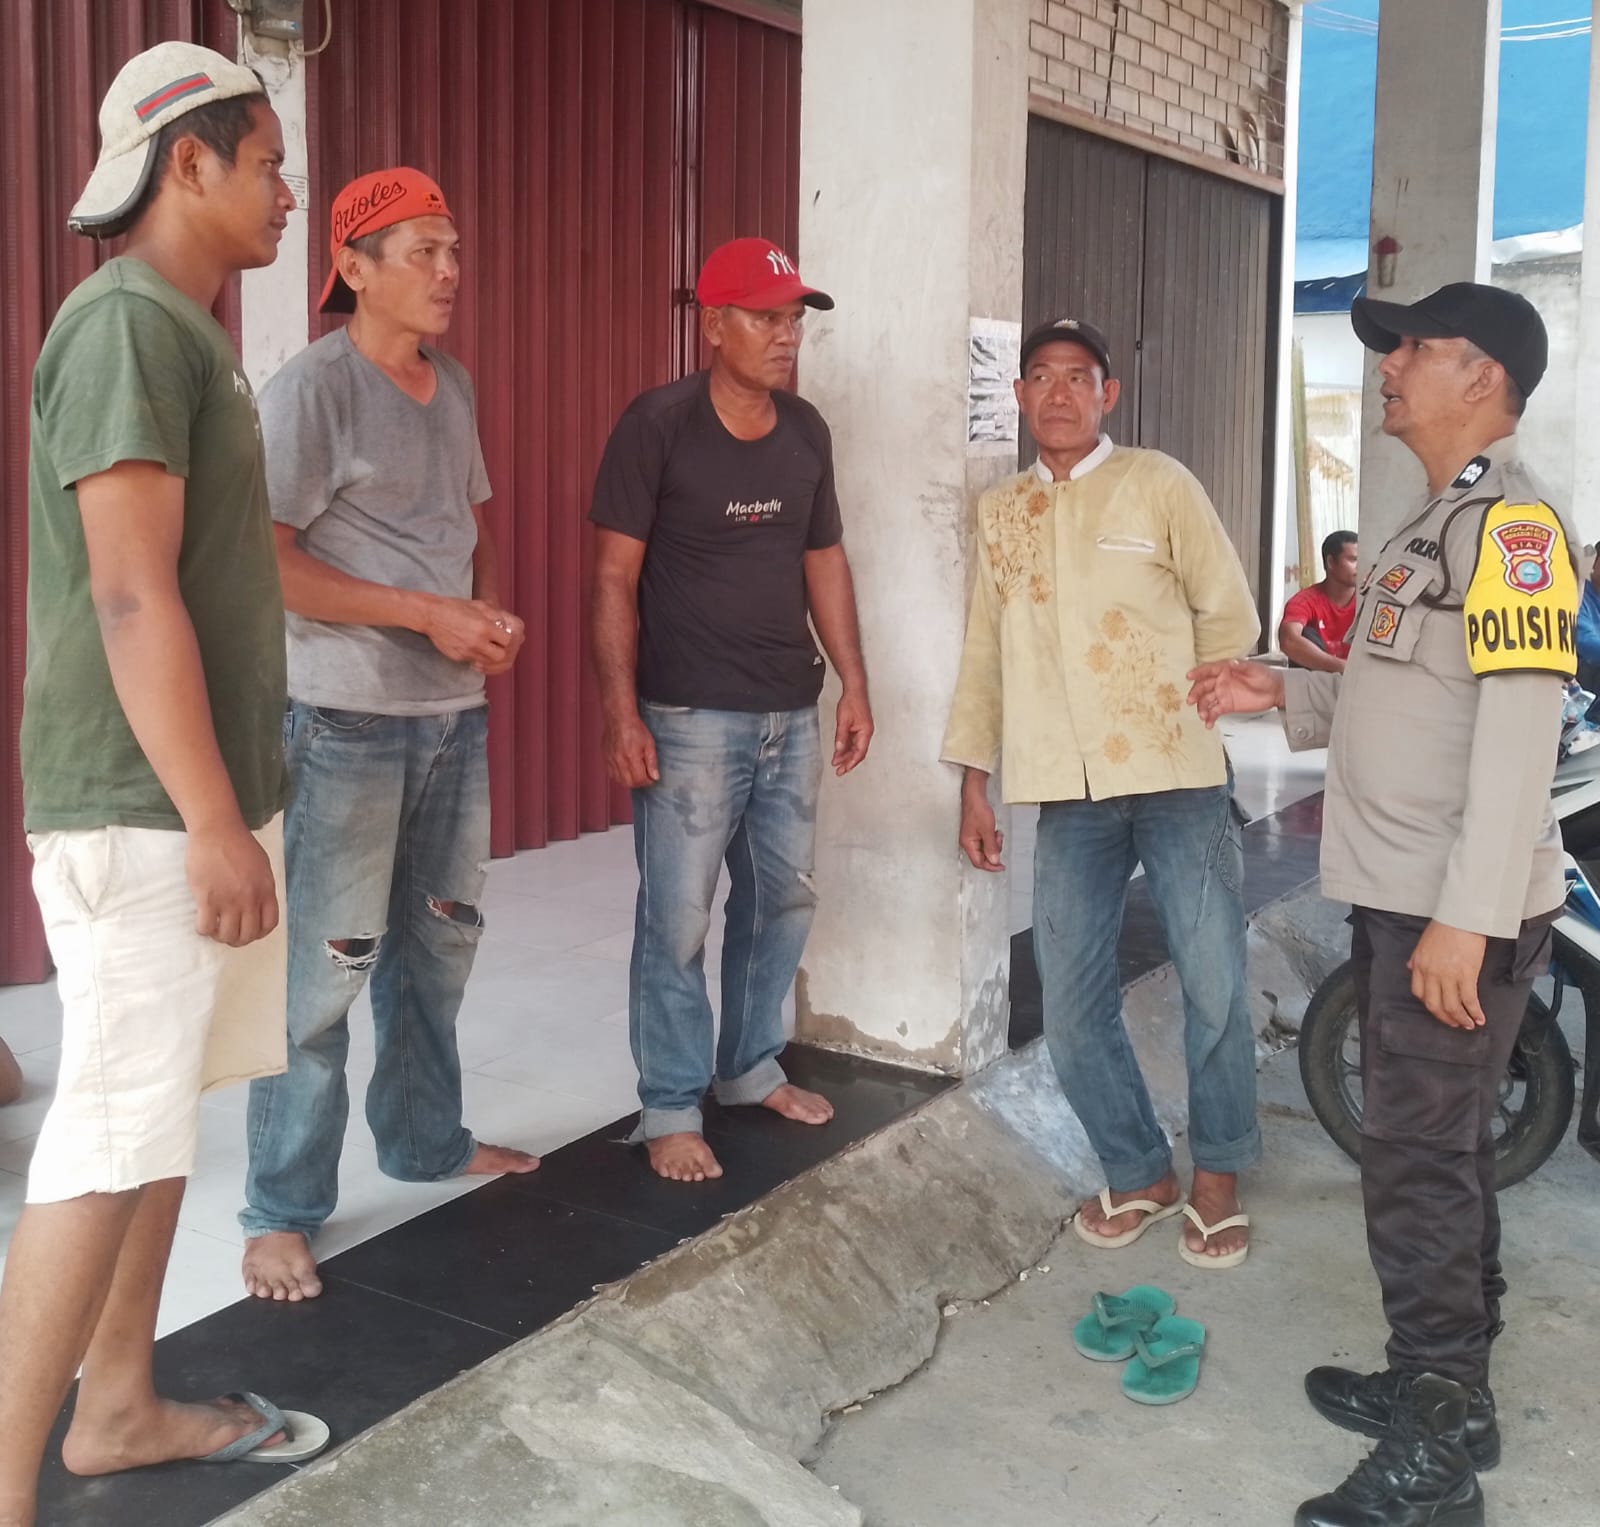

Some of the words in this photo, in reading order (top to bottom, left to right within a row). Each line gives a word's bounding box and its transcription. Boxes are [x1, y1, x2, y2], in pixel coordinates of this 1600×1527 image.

[334, 181, 407, 243] Orioles
[725, 498, 782, 516] Macbeth
[1467, 605, 1552, 657] POLISI
